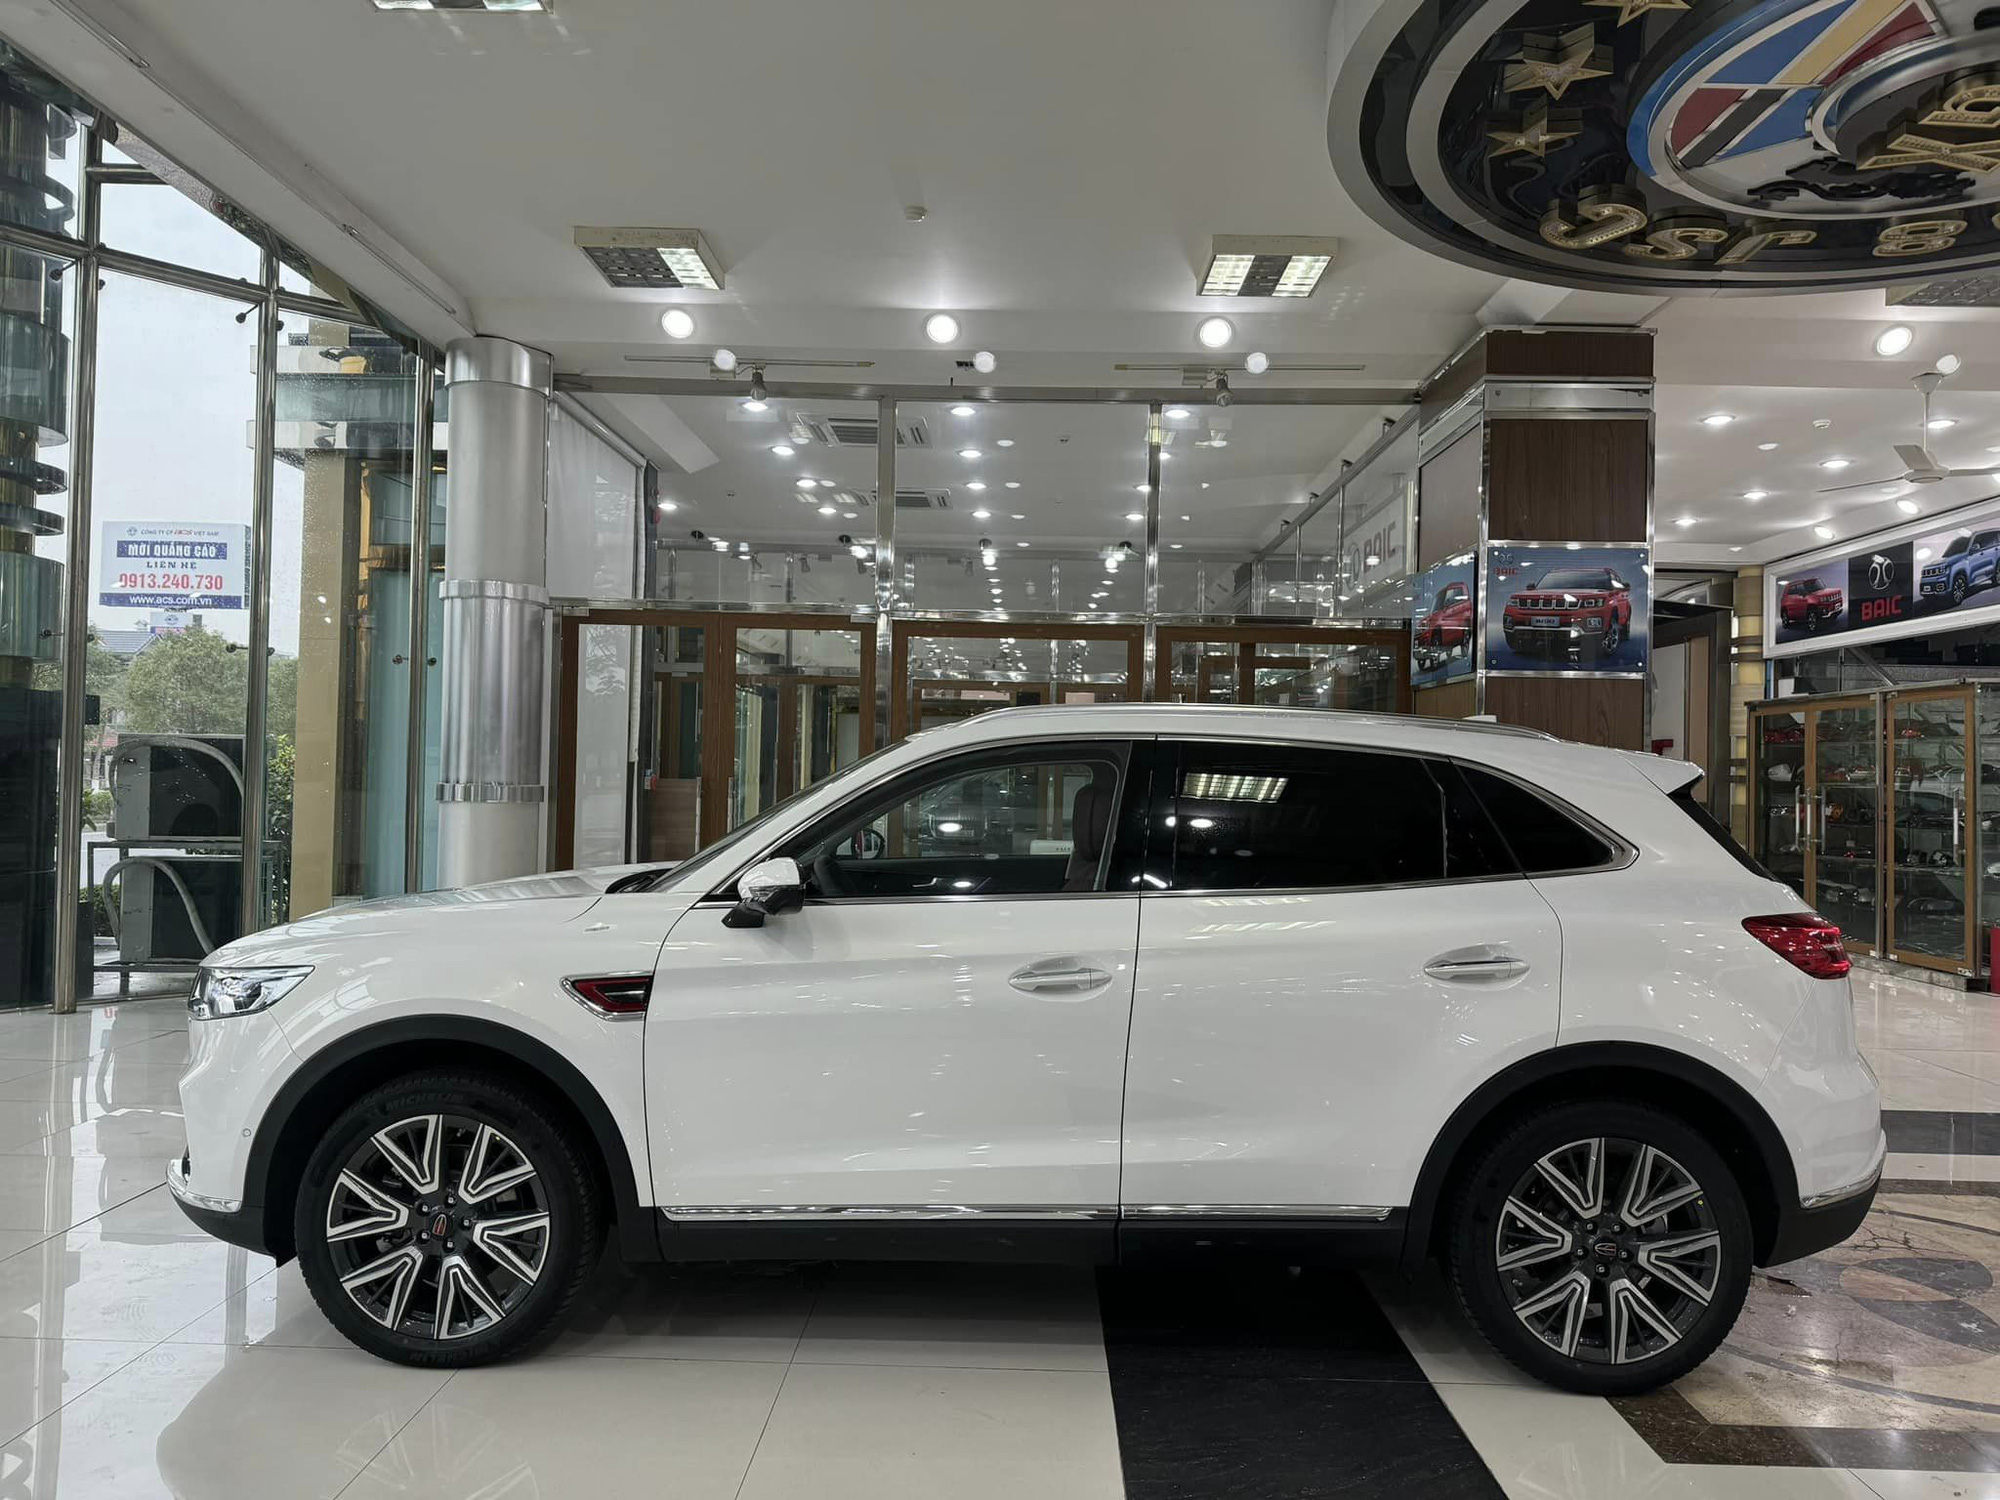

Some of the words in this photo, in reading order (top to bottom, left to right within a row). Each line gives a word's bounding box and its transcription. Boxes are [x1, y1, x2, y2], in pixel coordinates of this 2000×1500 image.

[119, 573, 223, 590] 0913.240.730
[129, 595, 212, 605] www.acs.com.vn
[1861, 594, 1902, 622] BAIC
